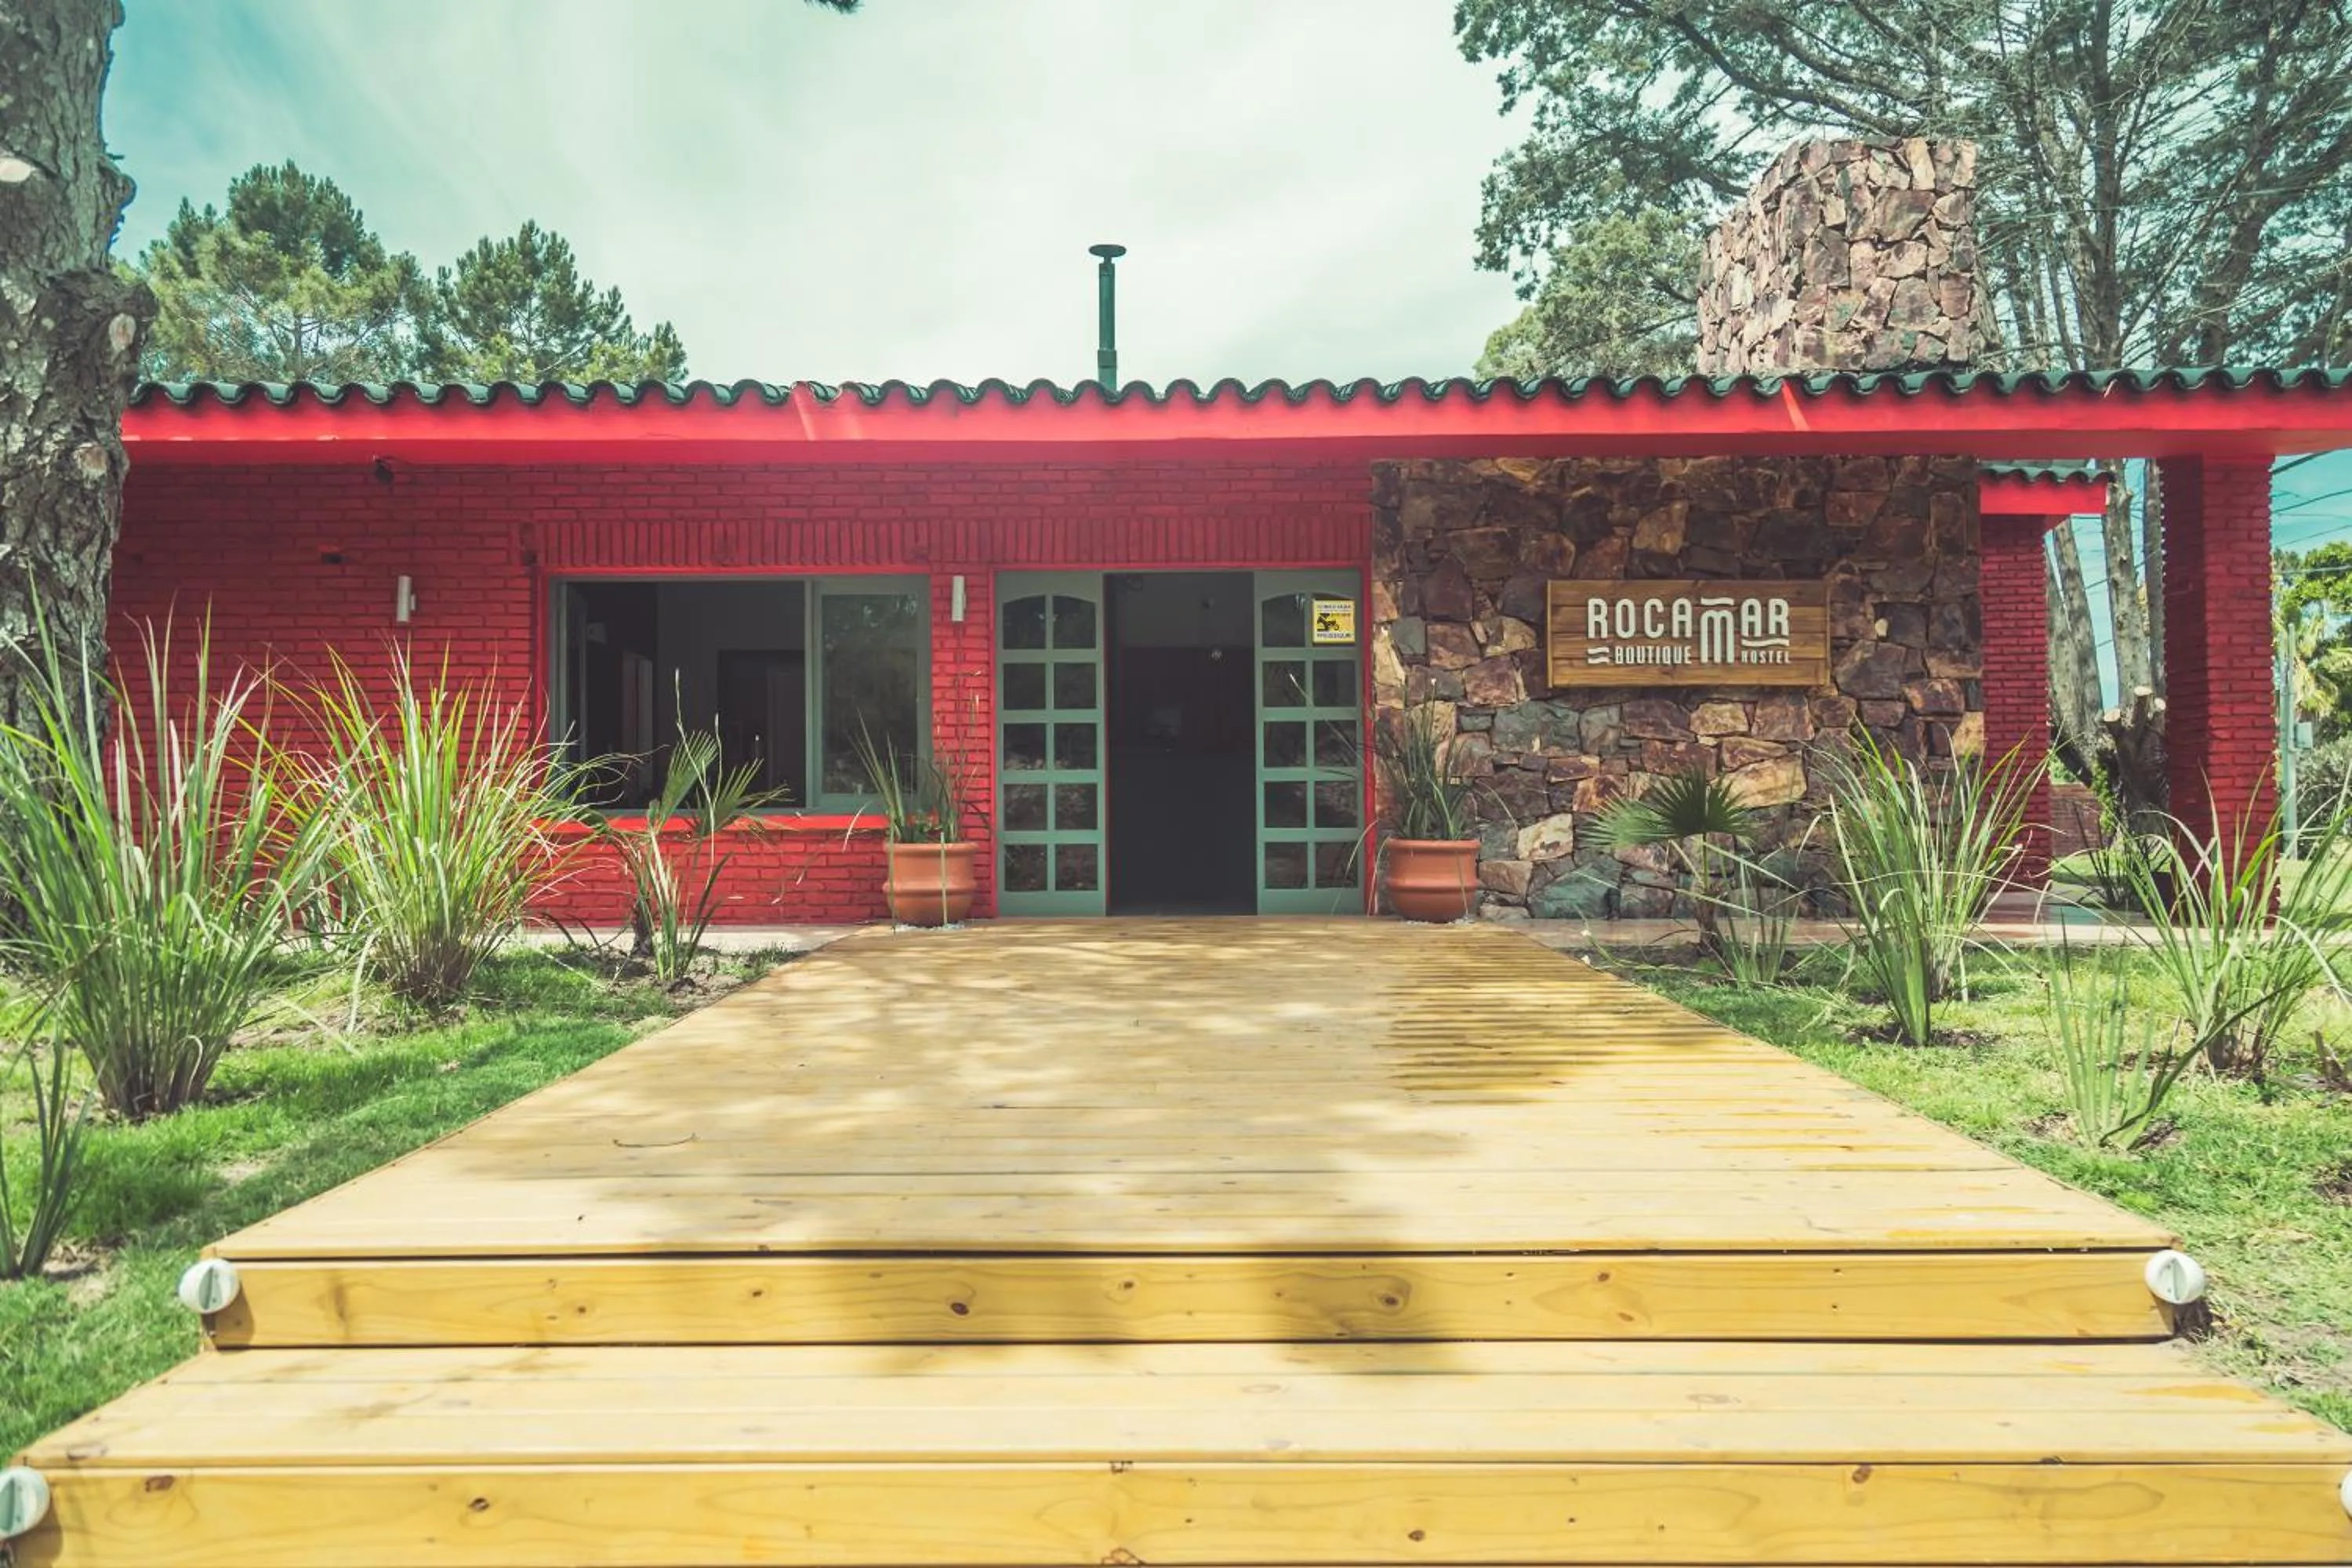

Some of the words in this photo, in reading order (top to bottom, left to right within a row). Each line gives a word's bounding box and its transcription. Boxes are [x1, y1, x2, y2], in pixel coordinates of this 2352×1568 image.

[1588, 597, 1790, 663] ROCAMAR
[1615, 645, 1692, 665] BOUTIQUE
[1741, 650, 1791, 664] HOSTEL
